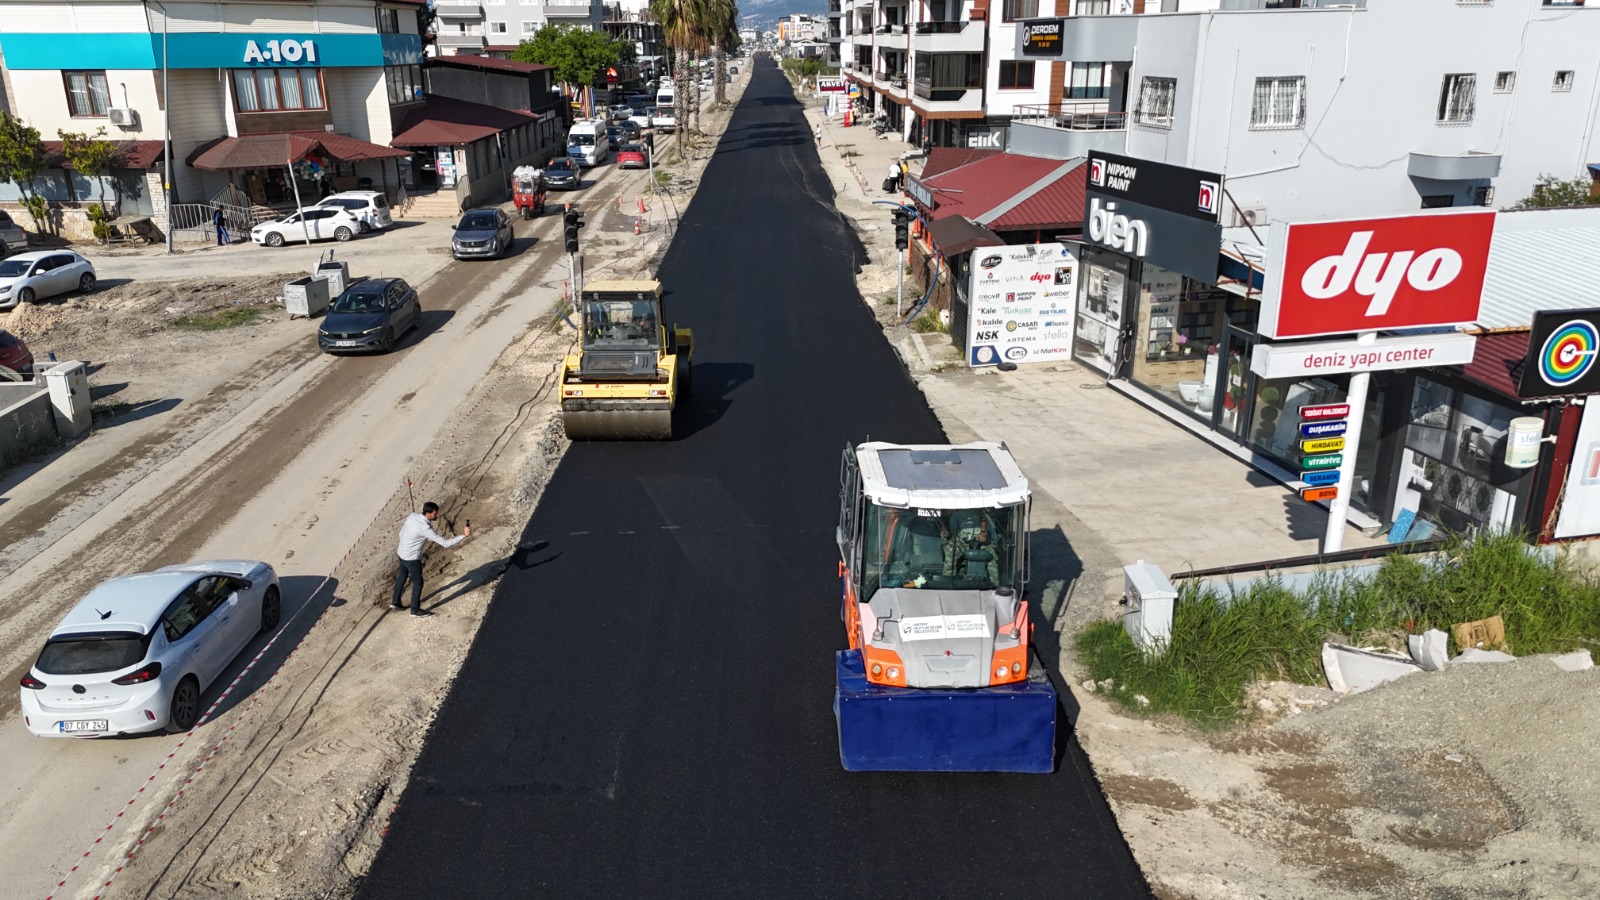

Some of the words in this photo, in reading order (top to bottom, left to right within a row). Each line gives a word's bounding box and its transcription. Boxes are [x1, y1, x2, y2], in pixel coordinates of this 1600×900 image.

[1107, 163, 1137, 180] NIPPON
[1107, 176, 1130, 191] PAINT
[1089, 198, 1147, 256] bien
[1030, 272, 1051, 283] dyo
[1301, 230, 1462, 317] dyo
[976, 331, 999, 341] NSK
[1043, 330, 1068, 340] stella
[1304, 353, 1345, 368] deniz
[1349, 352, 1381, 368] yapı
[1386, 348, 1434, 362] center
[1311, 441, 1343, 449] HIRDAVAT
[93, 721, 105, 729] 245
